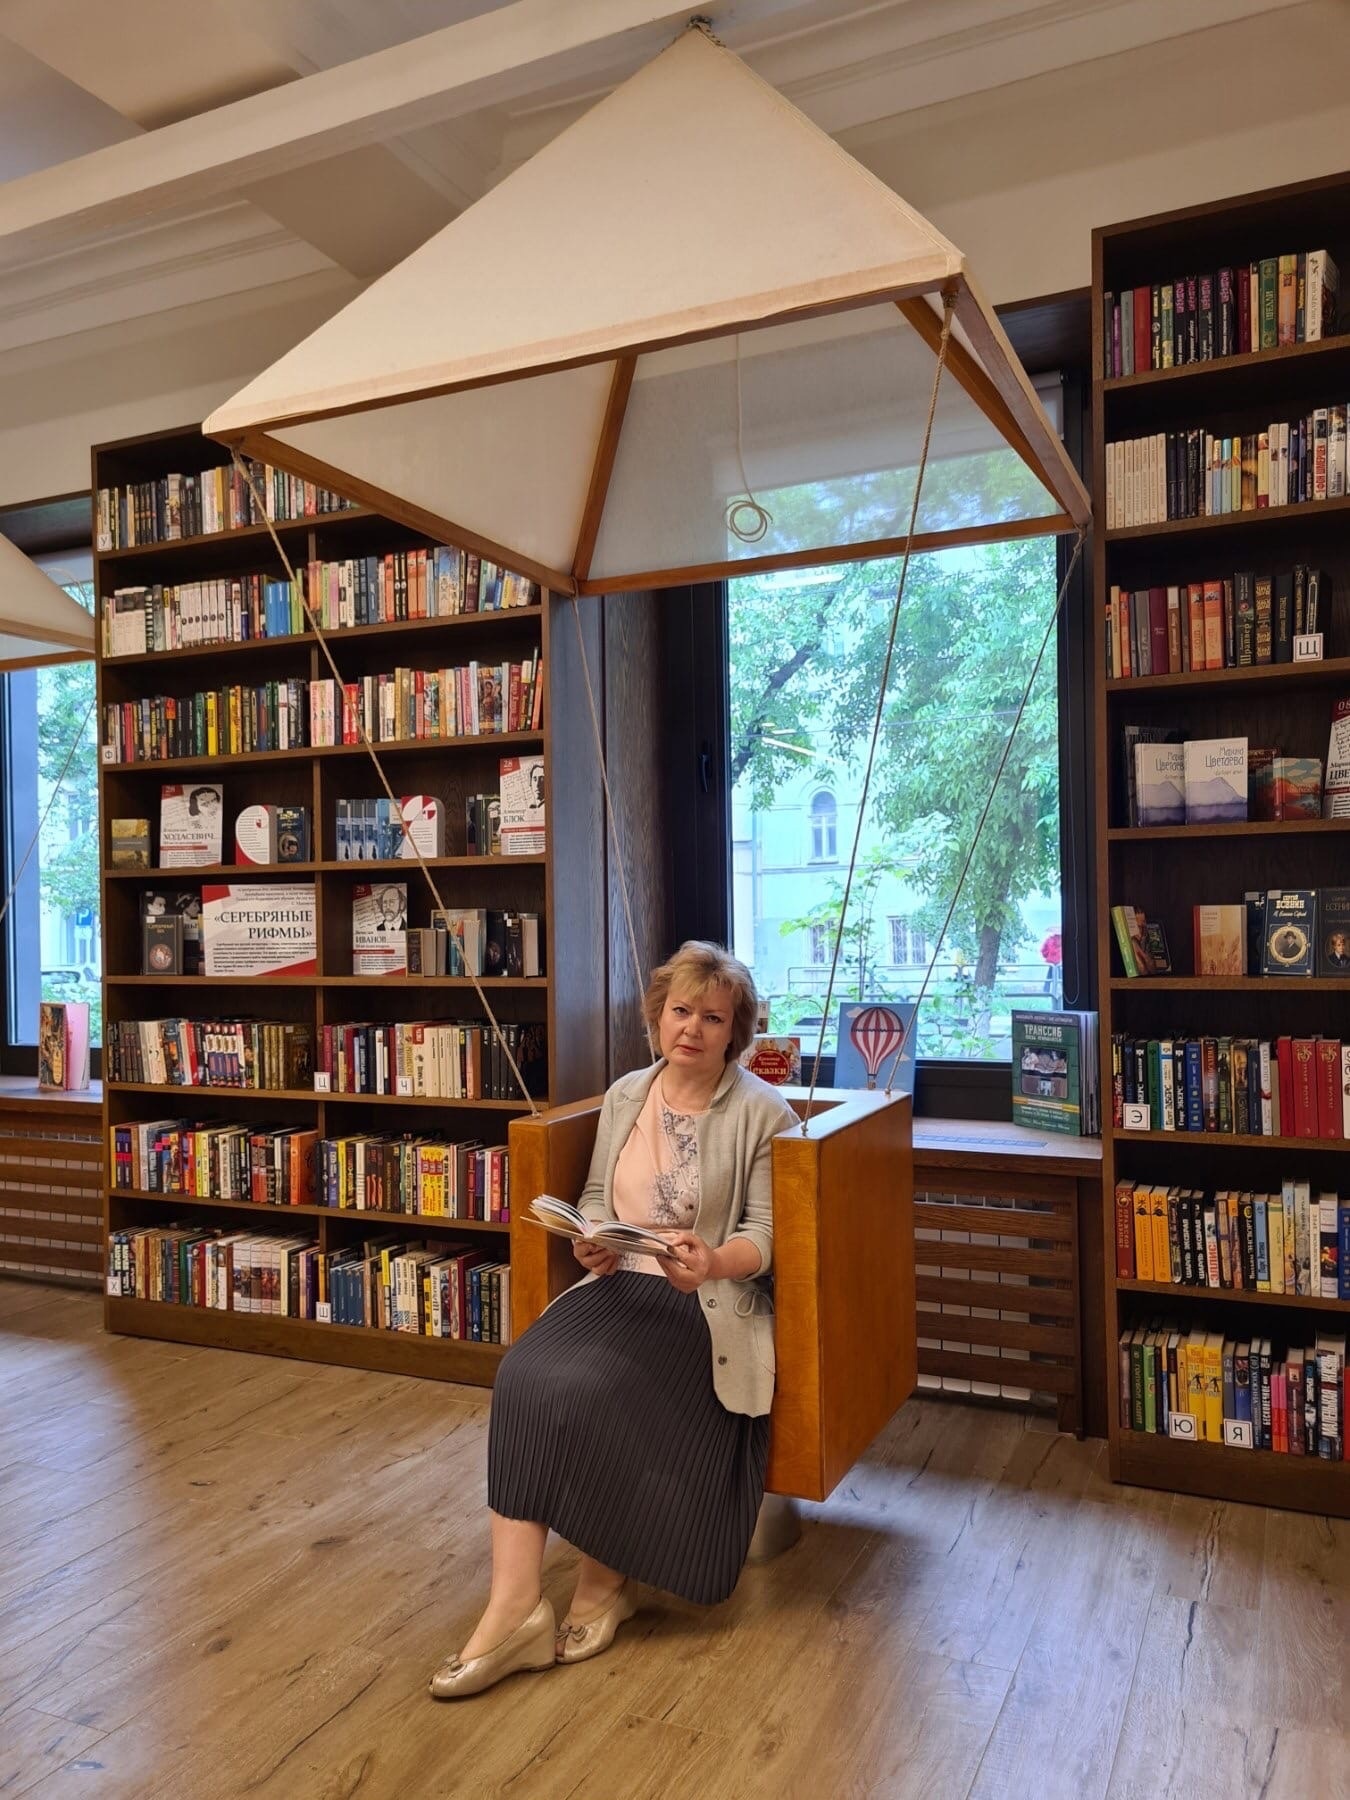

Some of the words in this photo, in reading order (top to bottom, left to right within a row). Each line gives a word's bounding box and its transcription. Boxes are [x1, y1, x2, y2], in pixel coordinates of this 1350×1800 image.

[1299, 640, 1318, 657] Щ
[104, 750, 113, 759] Ф
[503, 815, 525, 824] БЛОК
[214, 910, 313, 923] «СЕРЕБРЯНЫЕ
[248, 926, 312, 939] РИФМЫ»
[1024, 1024, 1063, 1038] ТРАНССИБ
[1131, 1109, 1143, 1124] Э
[1207, 1243, 1219, 1281] ЭЛЛИС
[319, 1307, 328, 1318] Ш
[1320, 1354, 1338, 1384] ЖИЗНЬ
[1321, 1388, 1338, 1438] МАЛЕНЬКАЯ
[1174, 1419, 1193, 1434] Ю
[1232, 1426, 1243, 1440] Я
